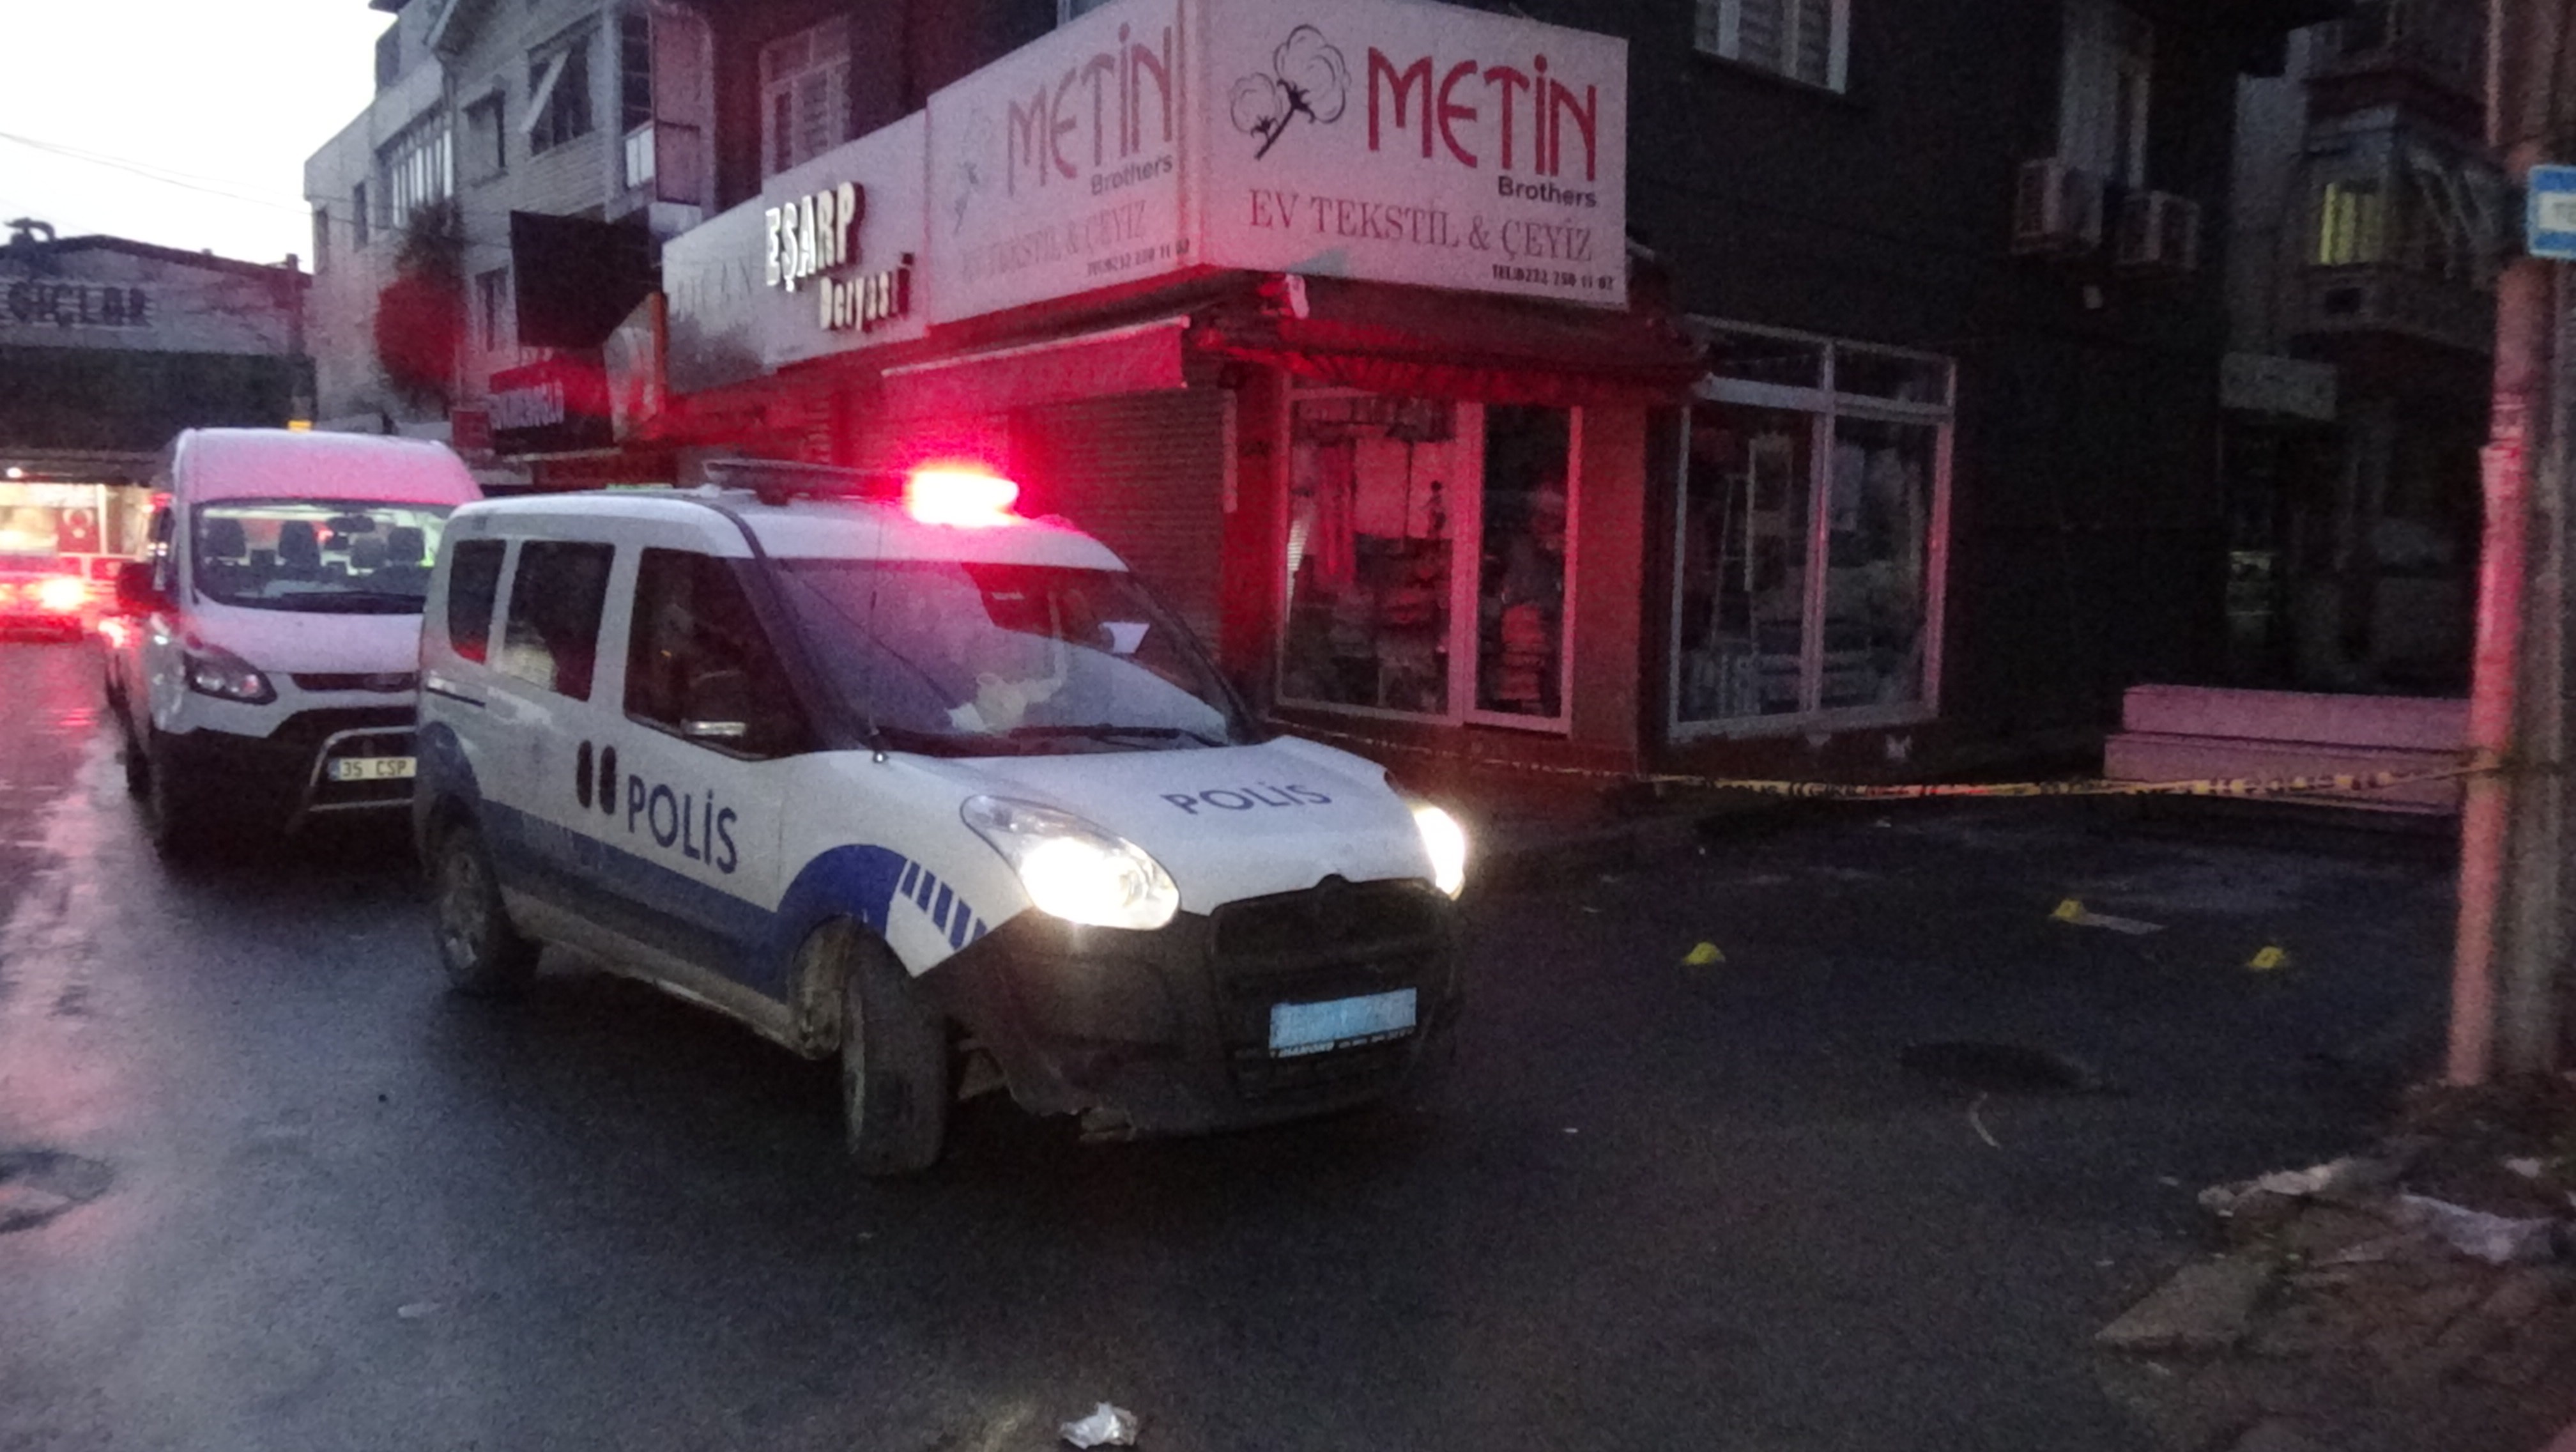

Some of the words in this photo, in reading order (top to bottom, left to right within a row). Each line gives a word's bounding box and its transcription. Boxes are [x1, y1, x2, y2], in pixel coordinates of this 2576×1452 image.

[1008, 22, 1172, 196] METİN
[1368, 46, 1596, 182] METİN
[1091, 155, 1172, 196] Brothers
[1498, 176, 1597, 208] Brothers
[1249, 189, 1299, 229] EV
[1469, 215, 1491, 251] &
[1501, 217, 1593, 261] ÇEYİZ
[1581, 274, 1593, 289] 11
[342, 761, 363, 778] 35
[376, 759, 407, 776] CSP
[1160, 782, 1333, 815] POLİS
[628, 774, 738, 875] POLİS
